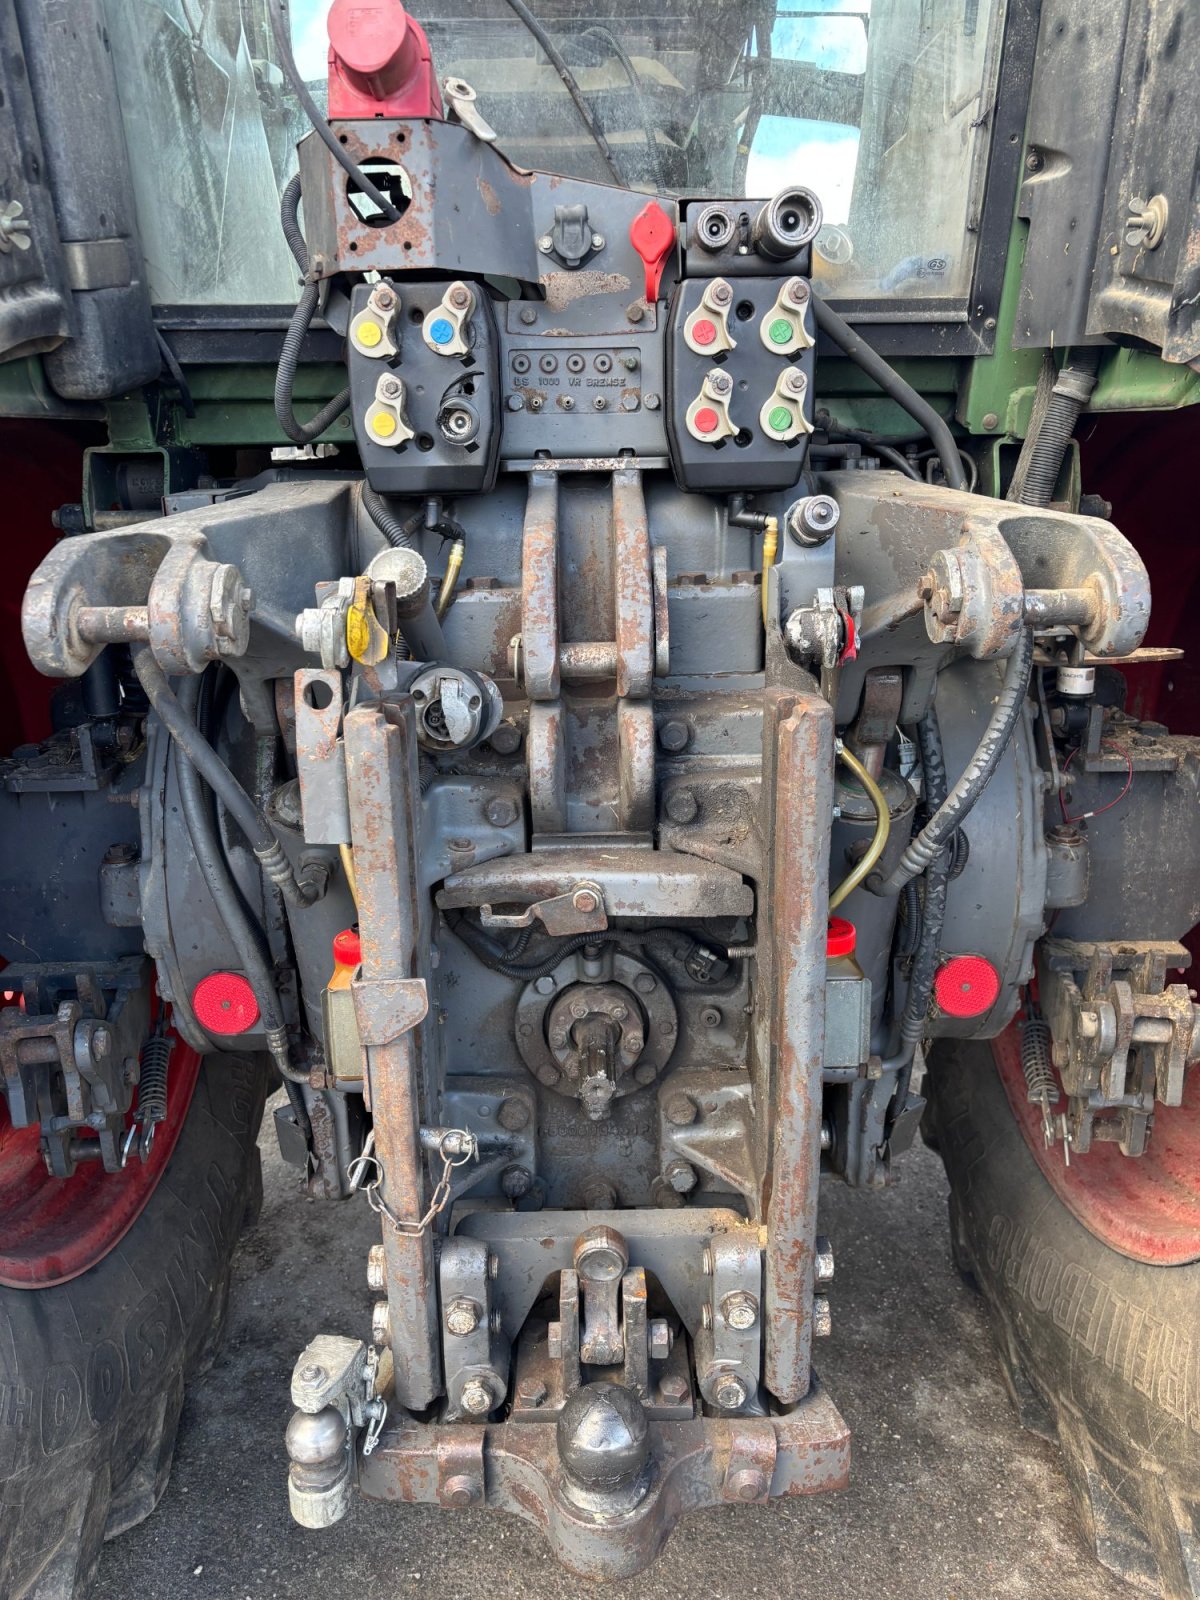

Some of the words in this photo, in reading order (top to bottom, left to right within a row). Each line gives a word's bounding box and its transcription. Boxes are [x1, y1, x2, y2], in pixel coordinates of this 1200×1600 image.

[538, 377, 560, 386] 1000
[568, 377, 581, 387] VR
[586, 377, 626, 387] BREMSE
